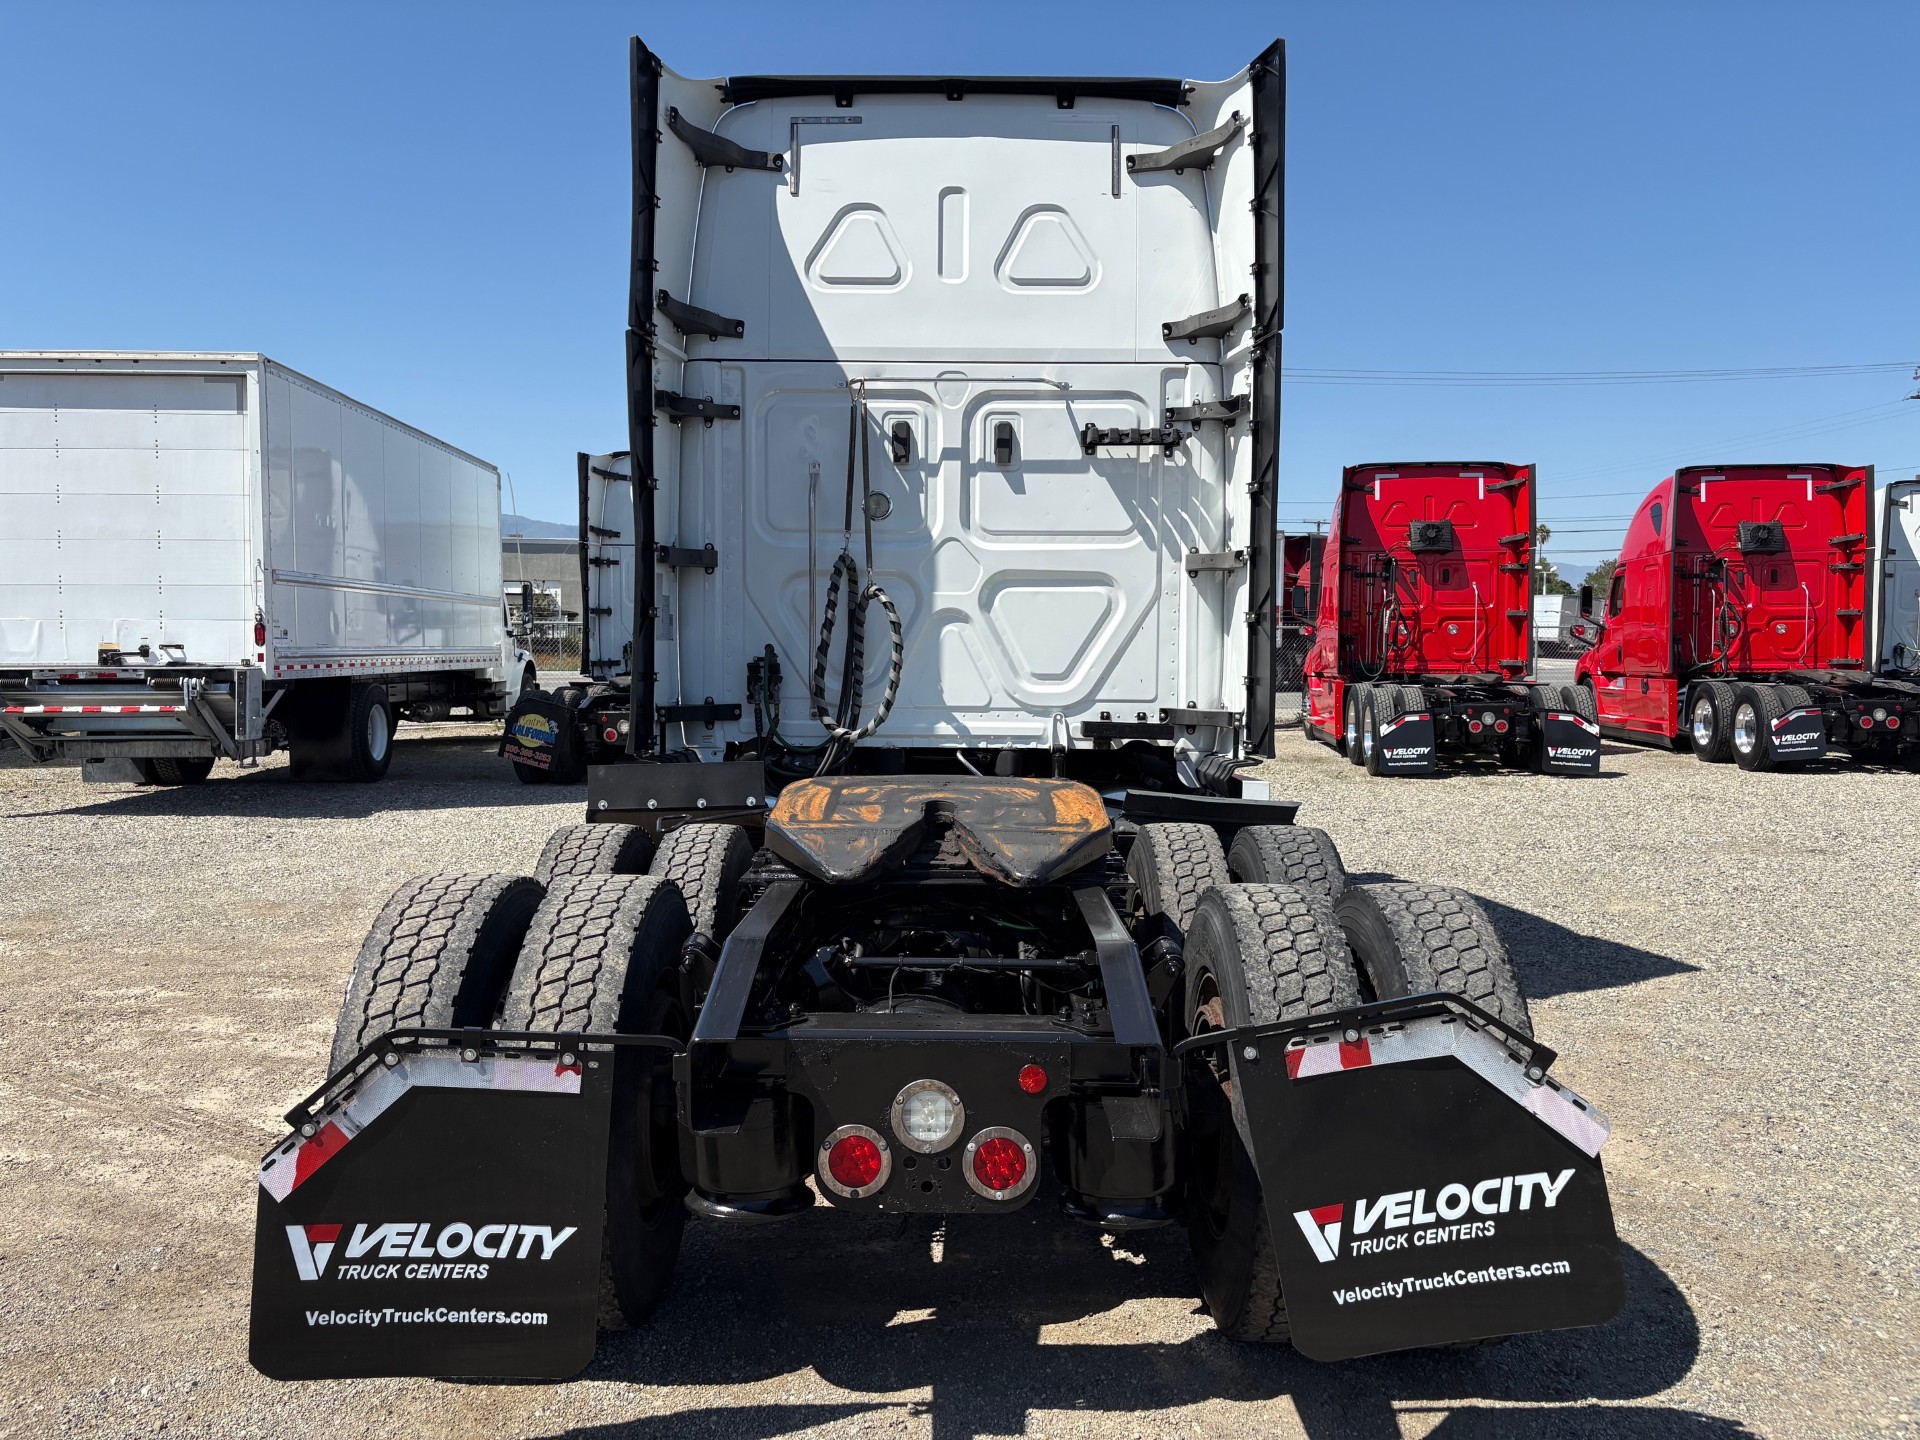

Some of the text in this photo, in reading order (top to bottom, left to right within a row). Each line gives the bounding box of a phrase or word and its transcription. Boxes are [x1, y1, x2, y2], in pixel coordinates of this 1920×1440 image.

[511, 722, 556, 744] CALIFORNIA
[1781, 732, 1820, 741] VELOCITY
[1393, 747, 1431, 755] VELOCITY
[1557, 747, 1597, 757] VELOCITY
[1352, 1168, 1576, 1235] VELOCITY
[345, 1221, 578, 1260] VELOCITY
[1350, 1220, 1496, 1257] TRUCK CENTERS
[337, 1263, 490, 1281] TRUCK CENTERS
[1332, 1259, 1571, 1306] VelocityTruckCenters.com
[305, 1306, 549, 1327] VelocityTruckCenters.com
